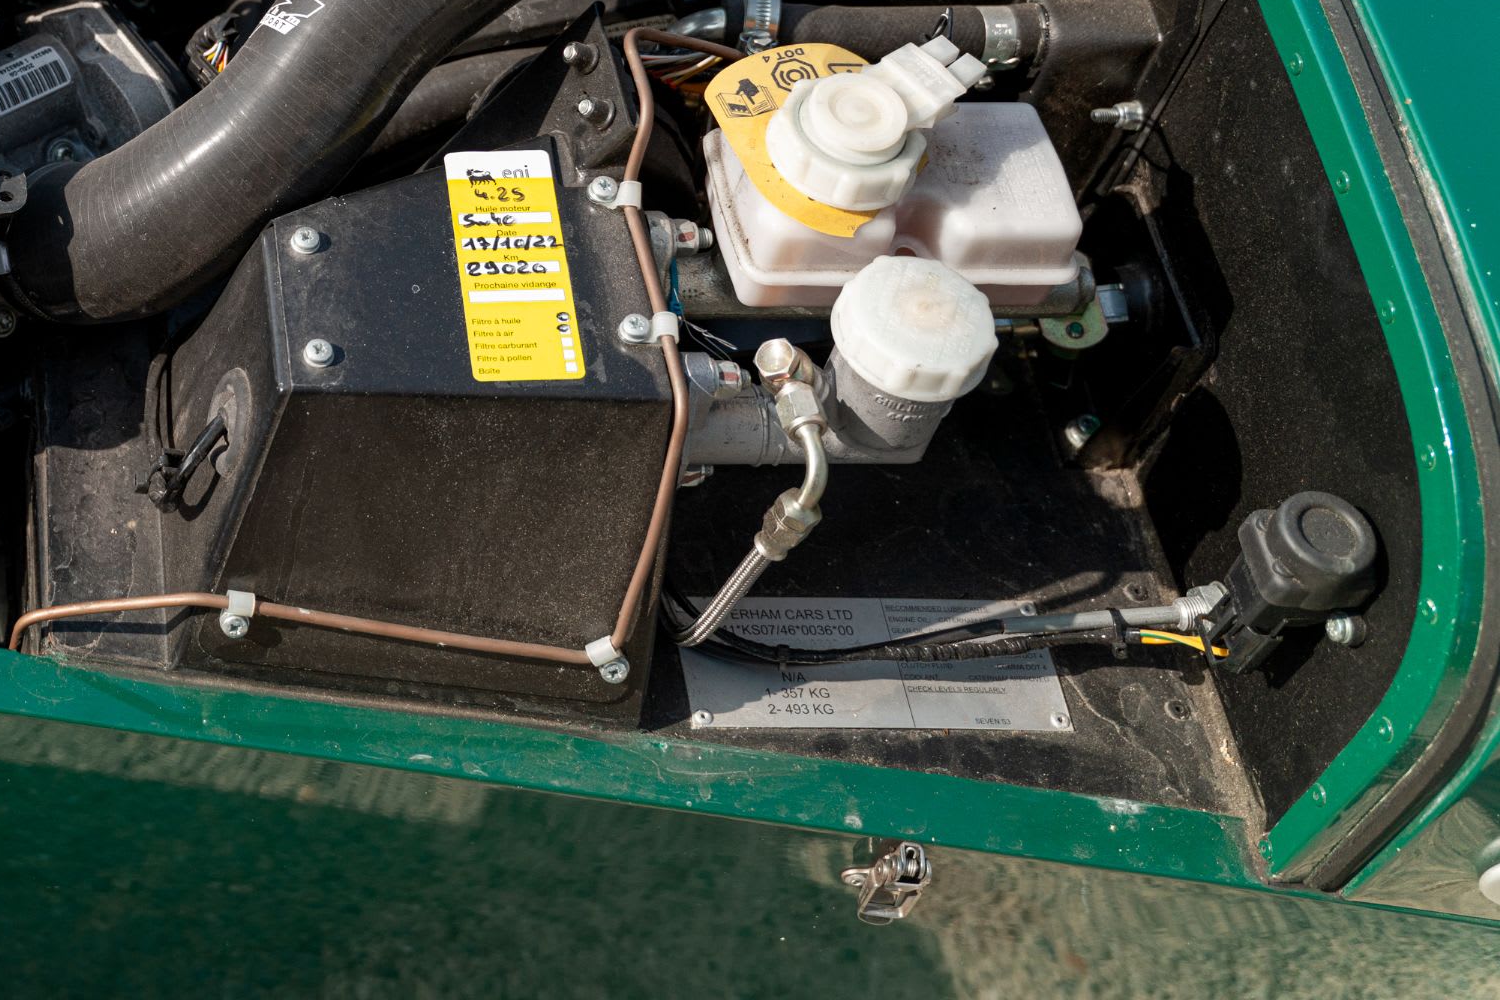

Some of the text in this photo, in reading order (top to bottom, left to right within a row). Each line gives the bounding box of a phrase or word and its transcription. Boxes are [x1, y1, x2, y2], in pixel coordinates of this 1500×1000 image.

[762, 48, 804, 64] DOT 4
[501, 165, 530, 179] eni
[466, 260, 547, 276] 29020
[521, 281, 557, 289] vidange
[501, 317, 521, 325] huile
[507, 354, 532, 362] pollen
[730, 608, 853, 621] ERHAM CARS LTD
[781, 671, 806, 682] N/A
[782, 687, 804, 699] 357
[809, 687, 831, 699] KG
[768, 703, 834, 715] 2- 493 KG
